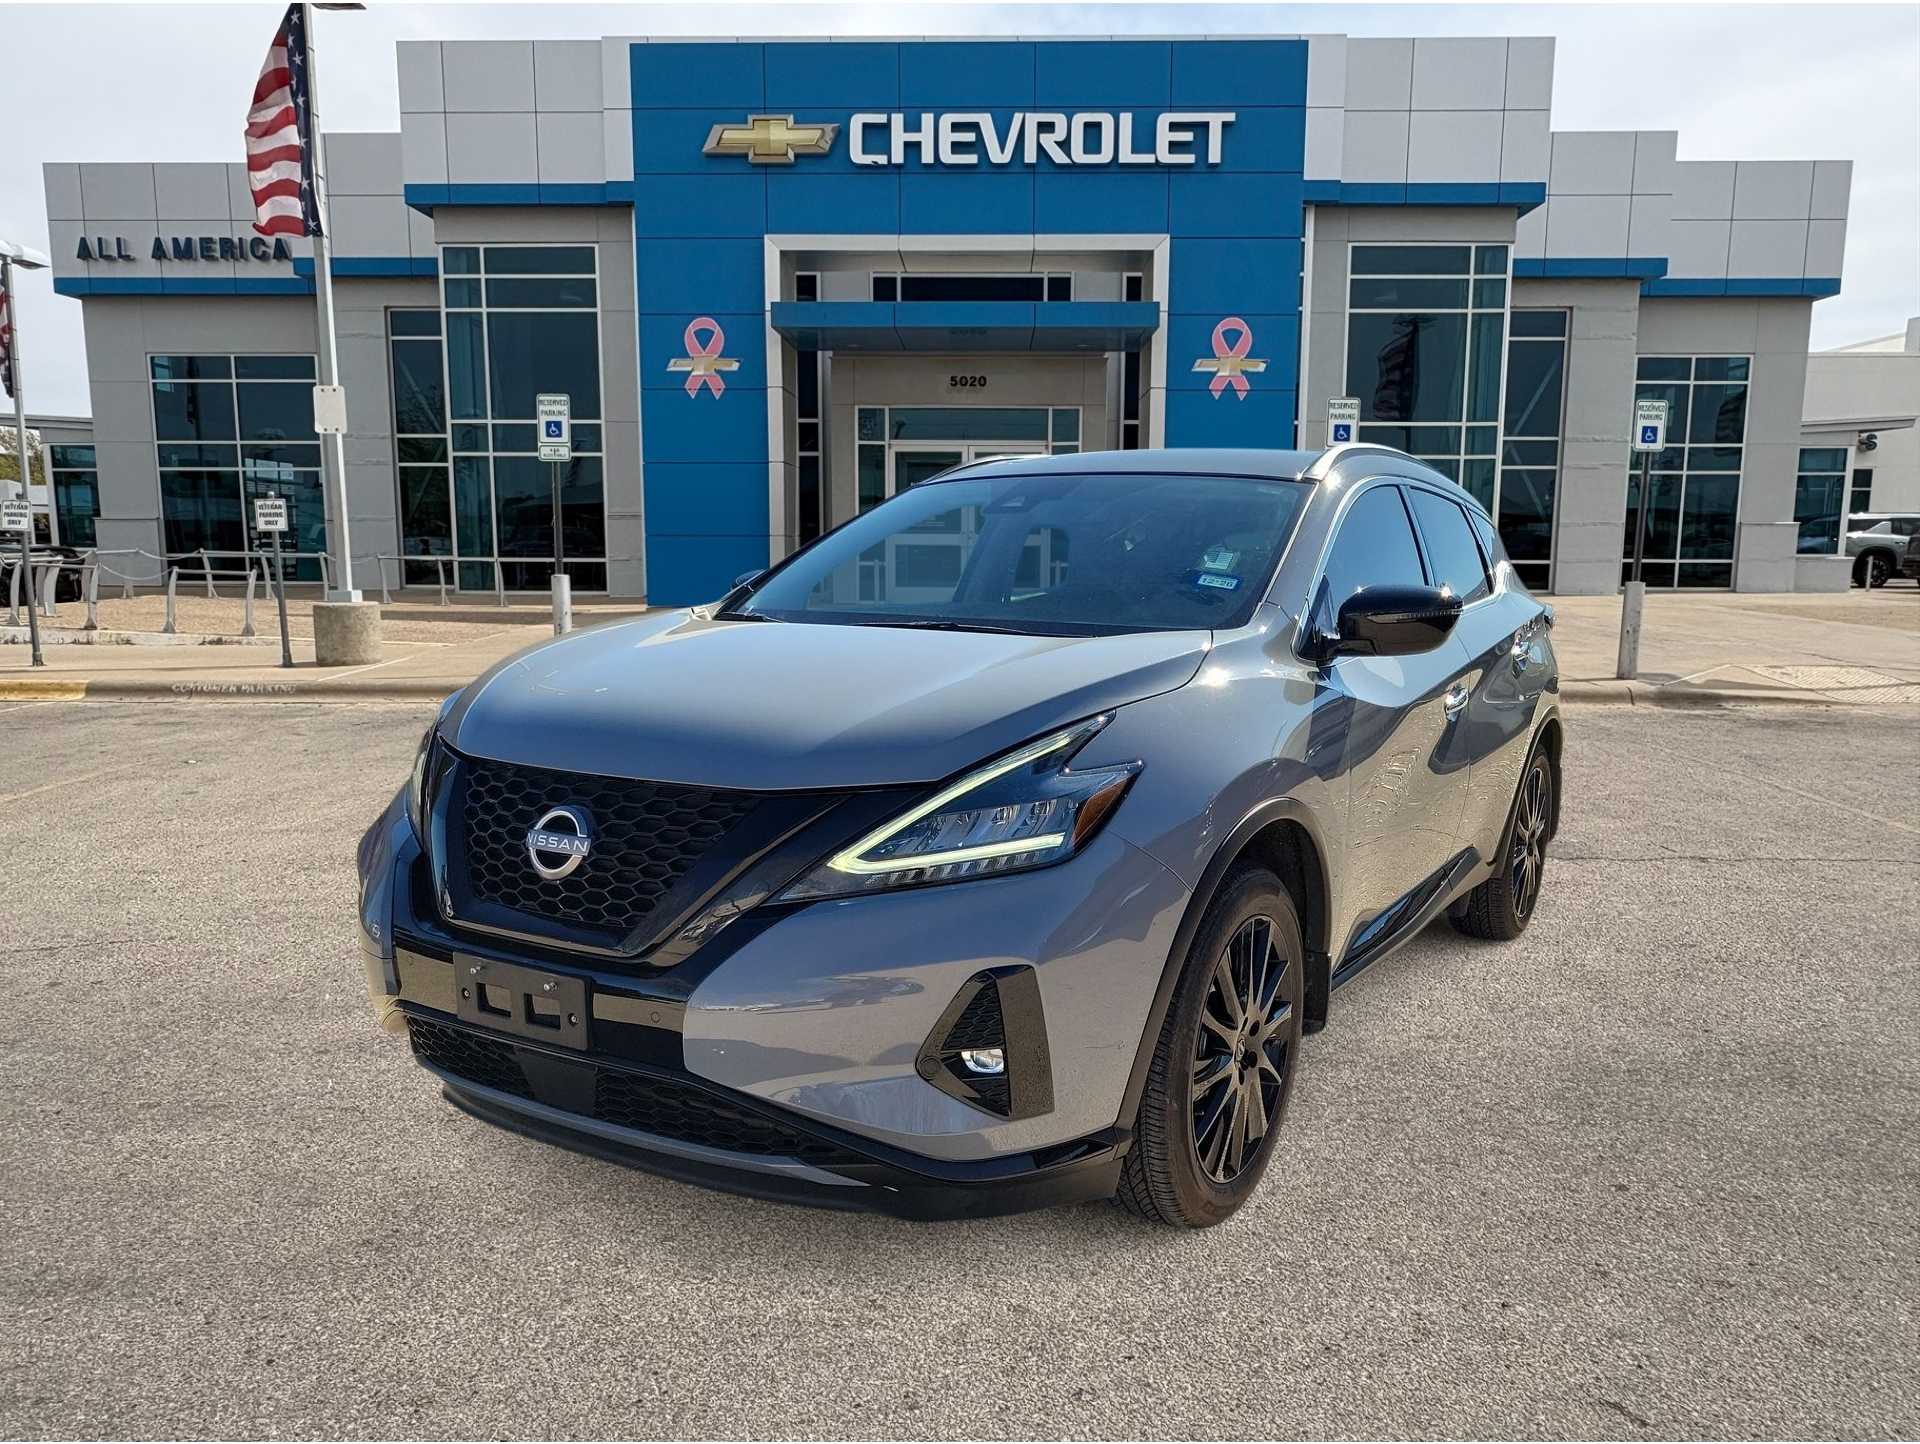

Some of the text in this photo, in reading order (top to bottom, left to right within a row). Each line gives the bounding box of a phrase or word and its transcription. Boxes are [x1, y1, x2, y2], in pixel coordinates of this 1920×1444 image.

[849, 112, 1236, 165] CHEVROLET
[77, 236, 135, 261] ALL
[950, 375, 987, 387] 5020
[541, 409, 567, 417] PARKING
[1638, 404, 1665, 412] RESERVED
[1640, 413, 1663, 421] PARKING
[527, 832, 588, 852] NISSAN
